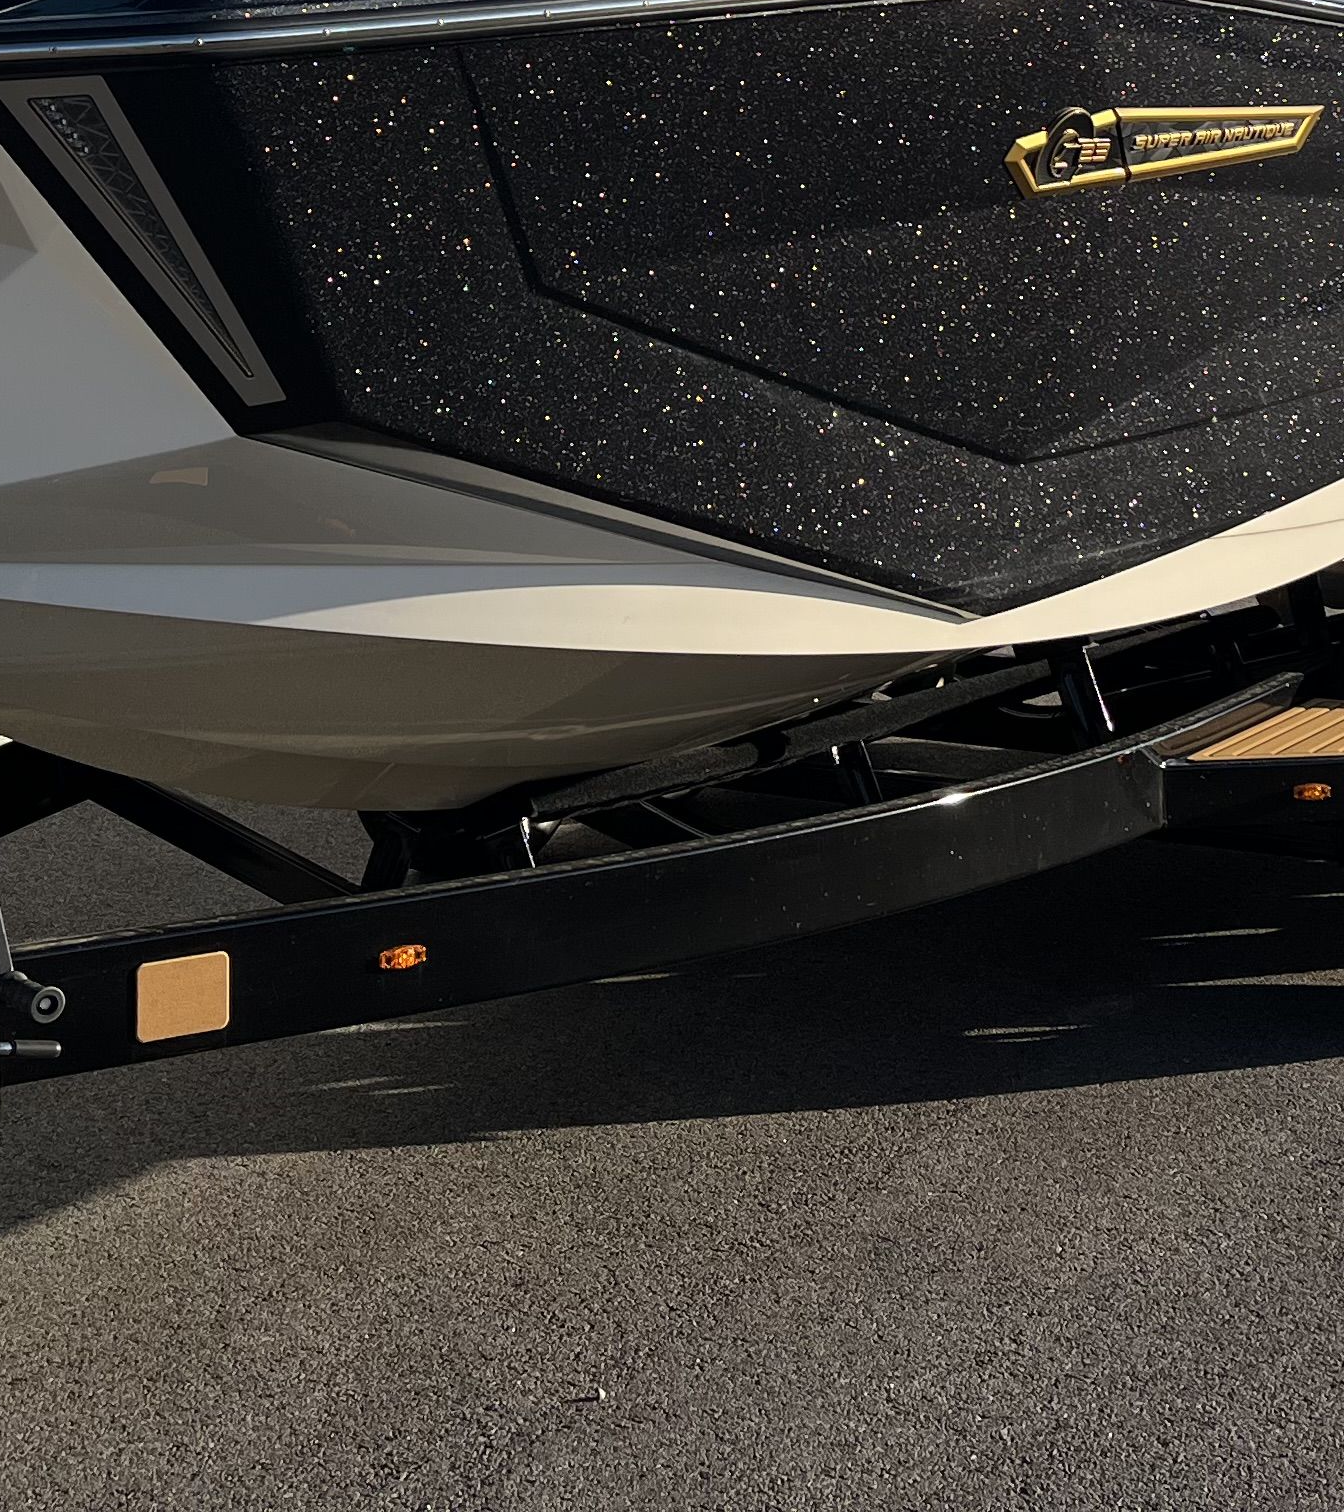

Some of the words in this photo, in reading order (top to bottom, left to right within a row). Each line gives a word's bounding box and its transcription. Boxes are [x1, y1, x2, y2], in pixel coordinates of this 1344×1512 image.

[1134, 131, 1193, 151] SUPER
[1194, 129, 1222, 145] AIR
[1223, 122, 1295, 143] NAUTIQUE
